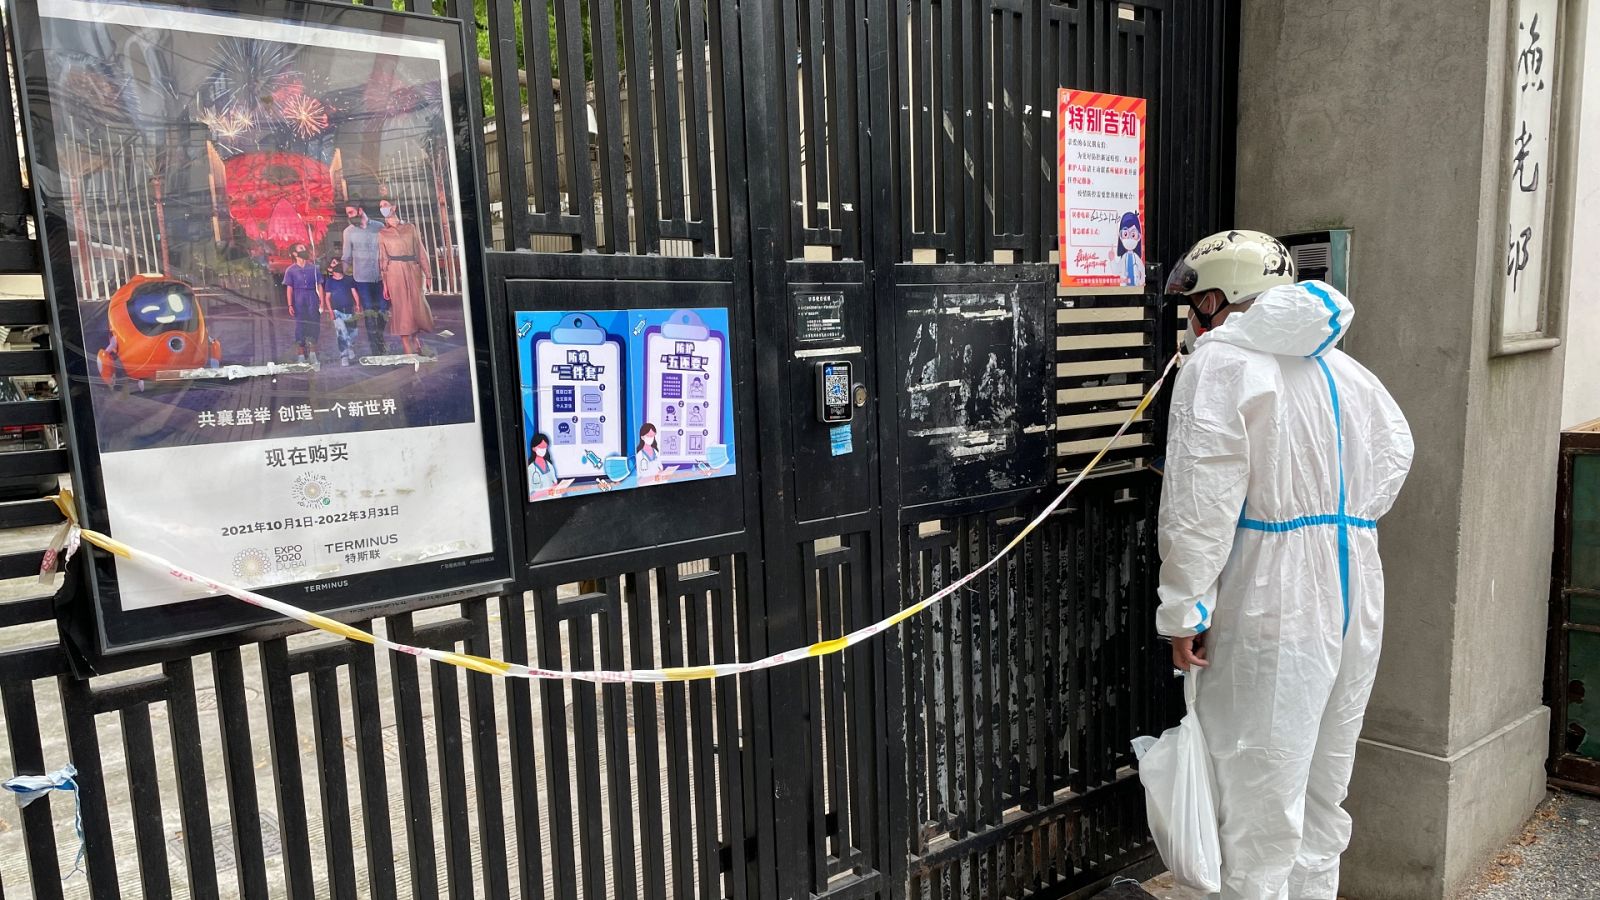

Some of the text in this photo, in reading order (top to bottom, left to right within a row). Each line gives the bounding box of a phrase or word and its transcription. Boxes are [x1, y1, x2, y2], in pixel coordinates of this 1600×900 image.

[1068, 105, 1137, 137] 特别告知
[198, 398, 397, 428] 共襄盛举 创造一个新世界
[265, 442, 349, 468] 现在购买
[221, 505, 400, 537] 2021年10月1日-2022年3月31日
[274, 544, 303, 555] EXPO
[324, 533, 399, 554] TERMINUS
[275, 553, 302, 563] 2020
[276, 561, 307, 571] DUBAI
[344, 550, 381, 565] 特斯联
[303, 579, 349, 593] TERMINUS
